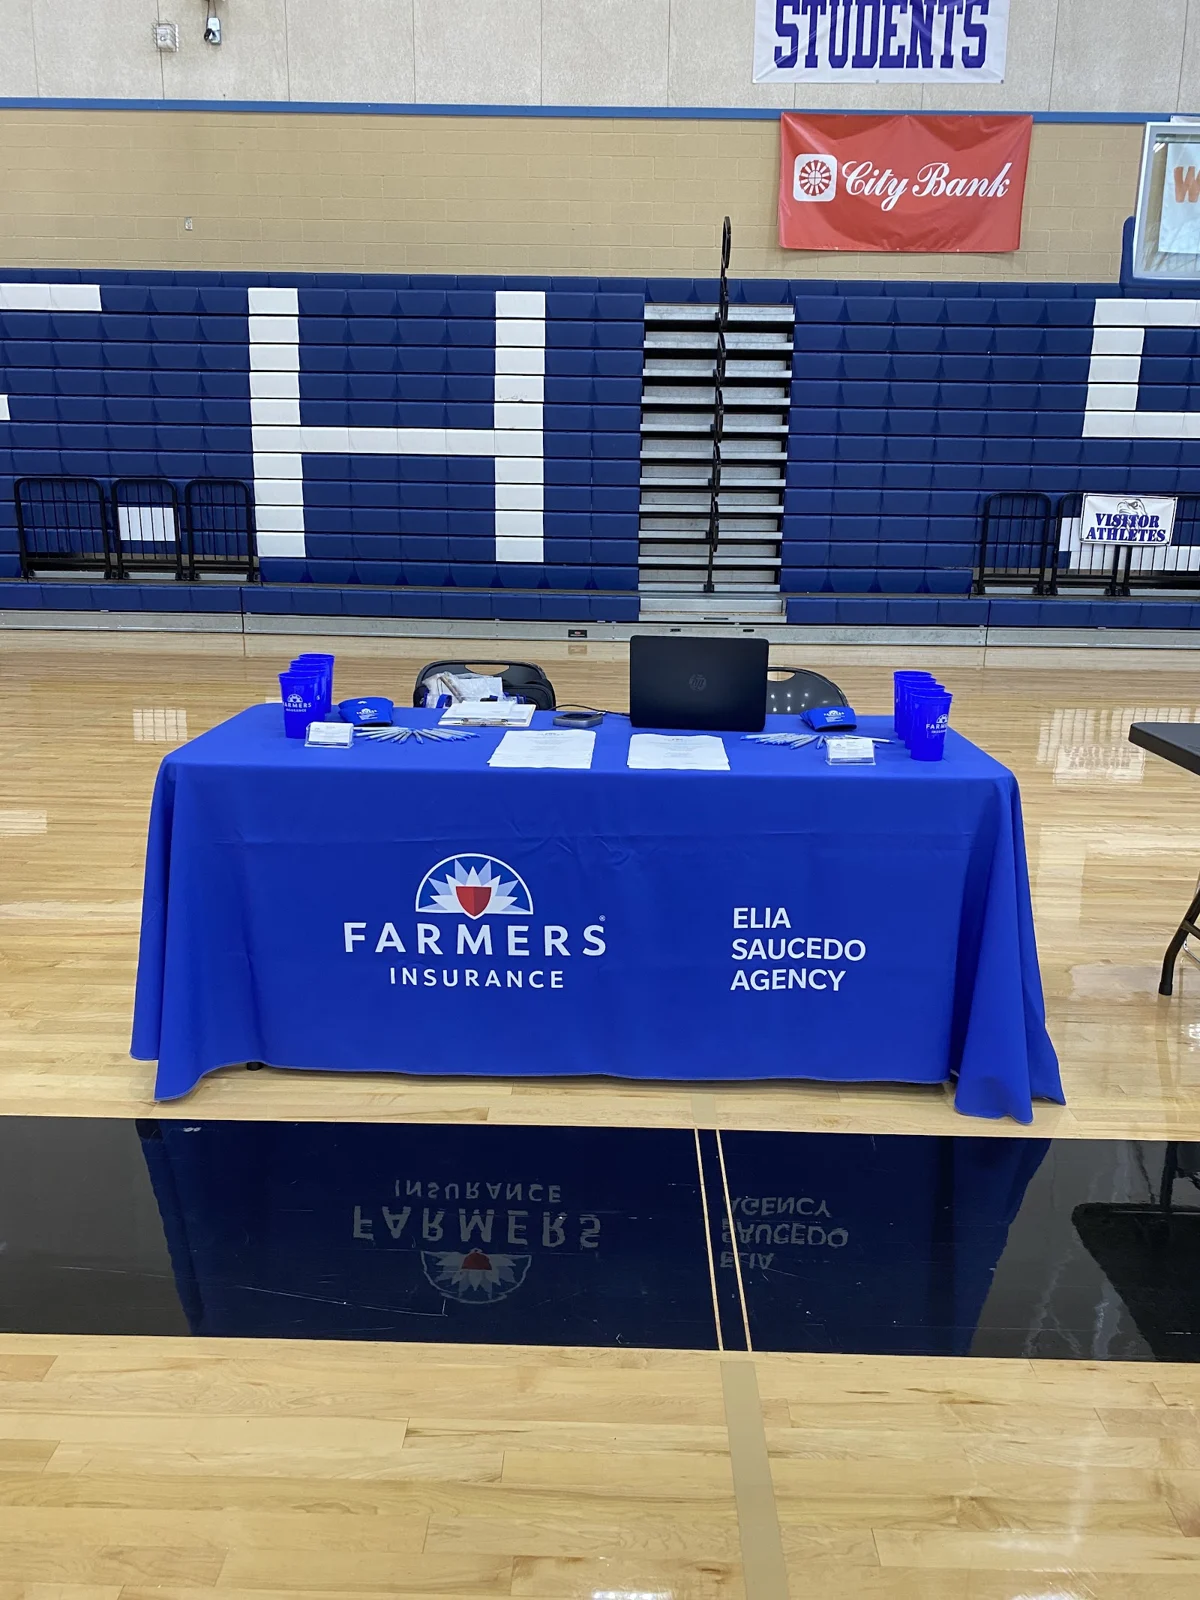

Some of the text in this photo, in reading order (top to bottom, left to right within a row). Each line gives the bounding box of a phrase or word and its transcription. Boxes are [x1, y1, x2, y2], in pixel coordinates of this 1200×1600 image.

[774, 0, 989, 69] STUDENTS
[841, 160, 1013, 212] City Bank
[1095, 512, 1160, 529] VISITOR
[1085, 526, 1167, 543] ATHLETES
[282, 701, 312, 709] ARMERS
[732, 907, 792, 929] ELIA
[731, 937, 867, 962] SAUCEDO
[389, 967, 564, 989] INSURANCE
[730, 968, 847, 992] AGENCY
